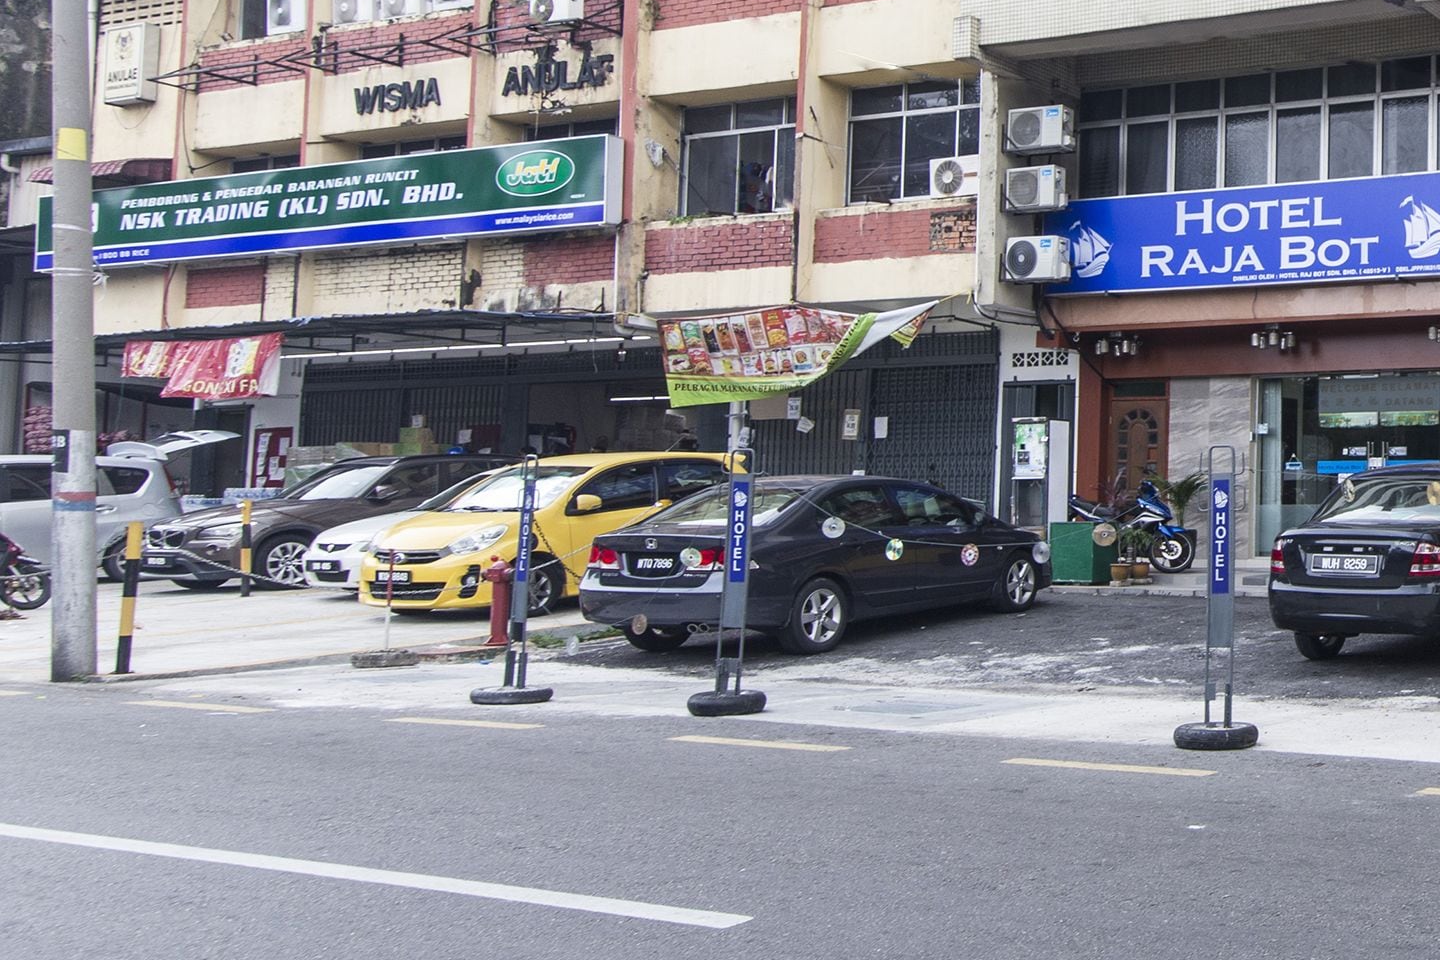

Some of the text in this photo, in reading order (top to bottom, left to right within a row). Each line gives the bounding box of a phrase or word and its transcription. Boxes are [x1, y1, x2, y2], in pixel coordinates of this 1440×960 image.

[354, 77, 442, 116] WISMA
[119, 211, 167, 231] NSK
[174, 199, 270, 227] TRADING
[278, 194, 328, 219] (KL)
[336, 188, 391, 211] SDN.
[402, 182, 464, 205] BHD.
[120, 169, 420, 210] PEMBORONG & PENGEDAR BARANGAN RUNCIT
[519, 512, 531, 572] HOTEL
[732, 510, 746, 572] HOTEL
[1214, 512, 1227, 582] HOTEL
[1321, 557, 1367, 570] WUH 8259
